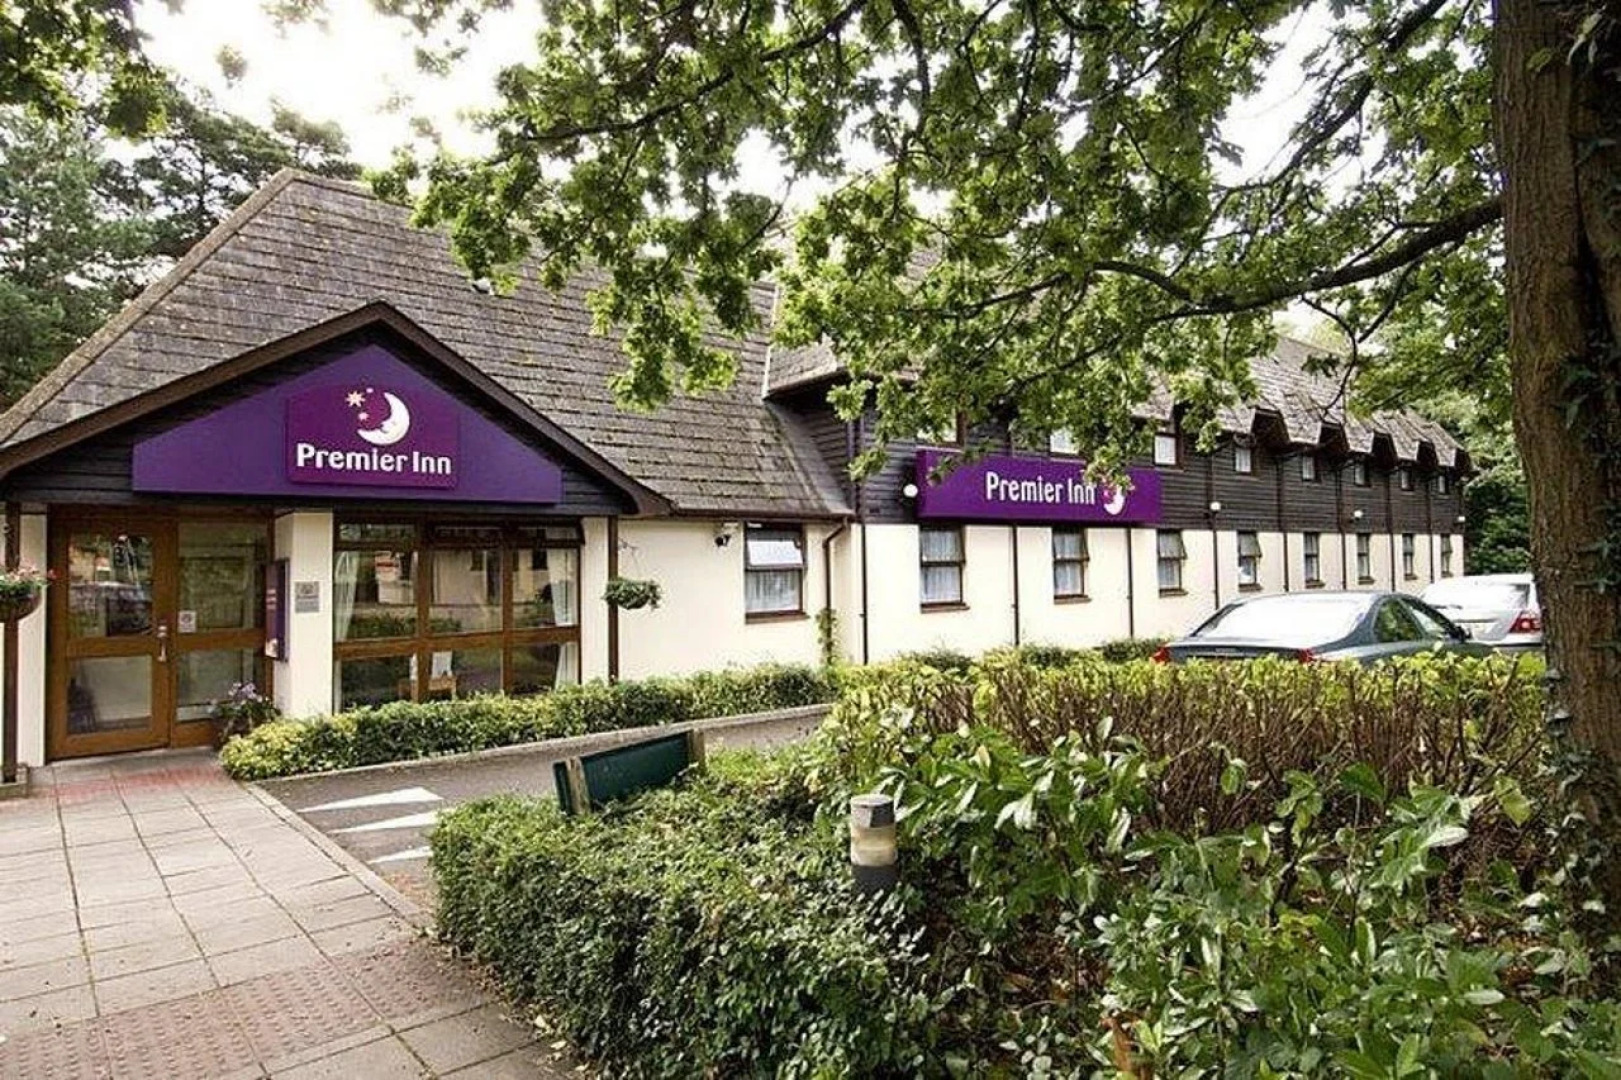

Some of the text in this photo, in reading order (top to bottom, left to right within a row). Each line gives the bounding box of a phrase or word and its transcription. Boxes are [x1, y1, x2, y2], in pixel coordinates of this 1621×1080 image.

[297, 442, 452, 475] Premier Inn
[986, 471, 1096, 505] Premier Inn
